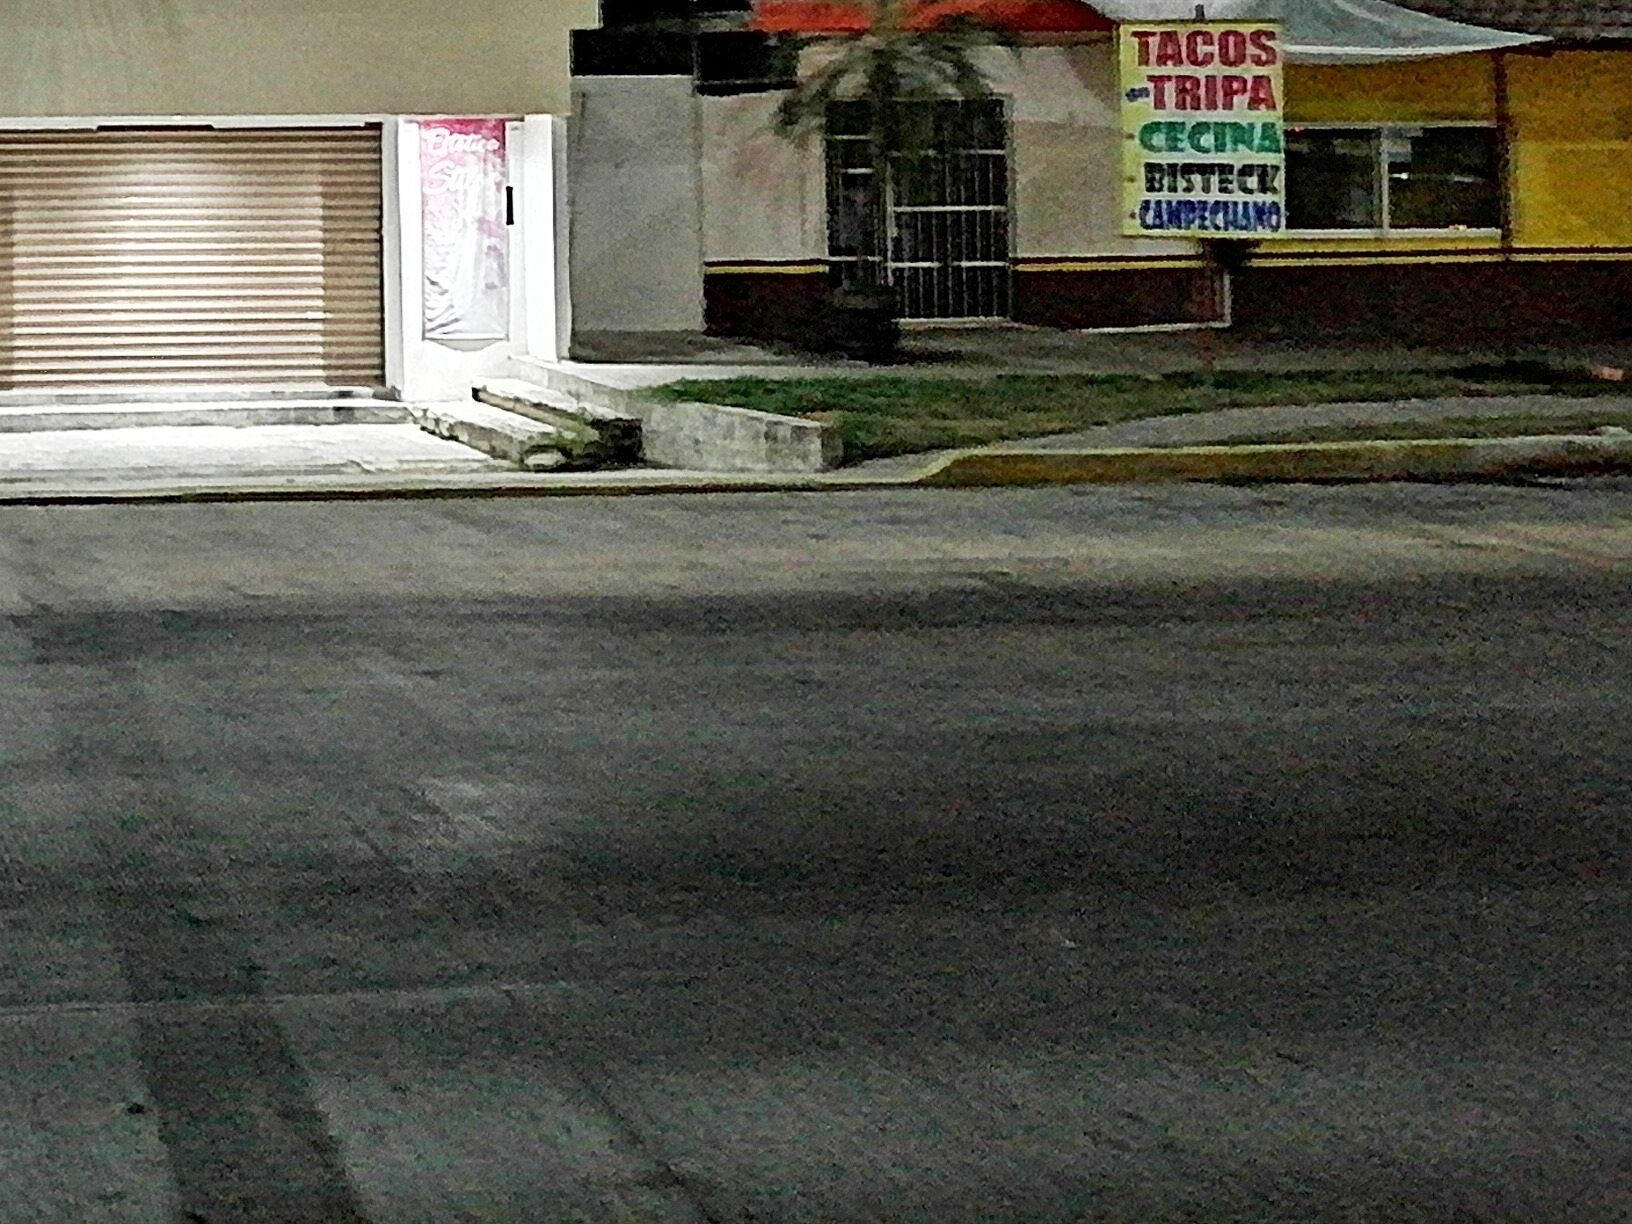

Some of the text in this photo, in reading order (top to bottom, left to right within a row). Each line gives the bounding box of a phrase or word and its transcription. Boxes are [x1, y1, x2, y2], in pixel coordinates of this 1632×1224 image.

[1131, 29, 1277, 67] TACOS
[1146, 75, 1277, 110] TRIPA
[1139, 121, 1282, 153] CECINA
[1144, 162, 1280, 194] BISTECK
